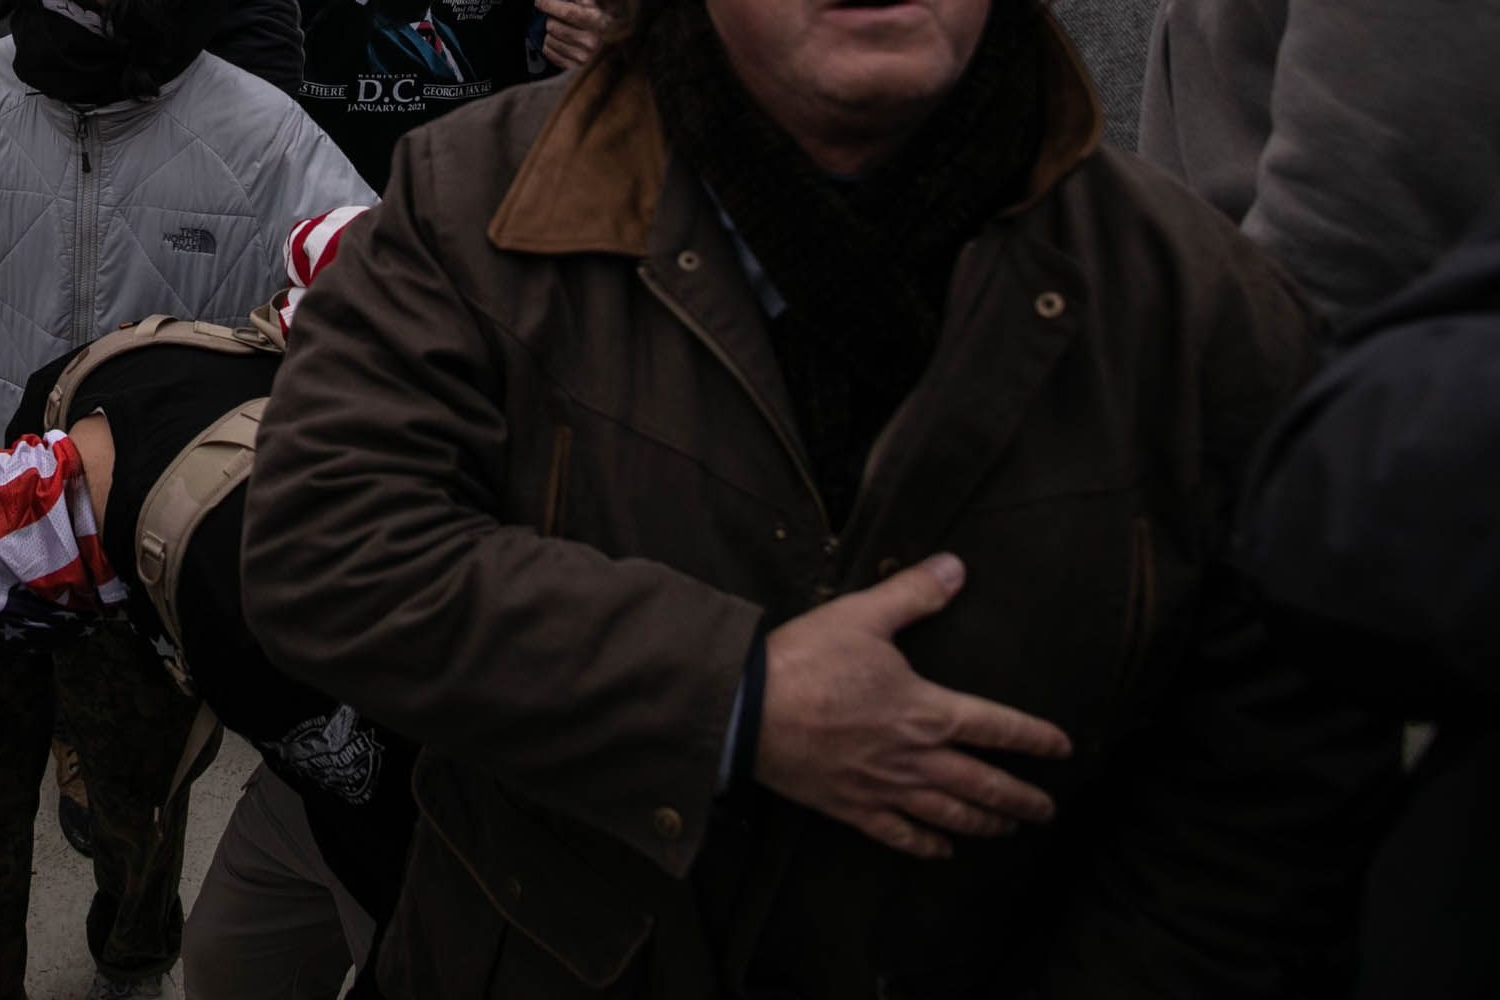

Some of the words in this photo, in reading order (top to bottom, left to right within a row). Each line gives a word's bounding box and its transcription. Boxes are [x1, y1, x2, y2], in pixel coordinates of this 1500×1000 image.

[310, 86, 345, 97] THERE
[357, 79, 421, 103] D.C.
[423, 86, 464, 97] GEORGIA
[347, 103, 397, 113] JANUARY
[398, 103, 406, 113] 6,
[408, 102, 426, 112] 2021
